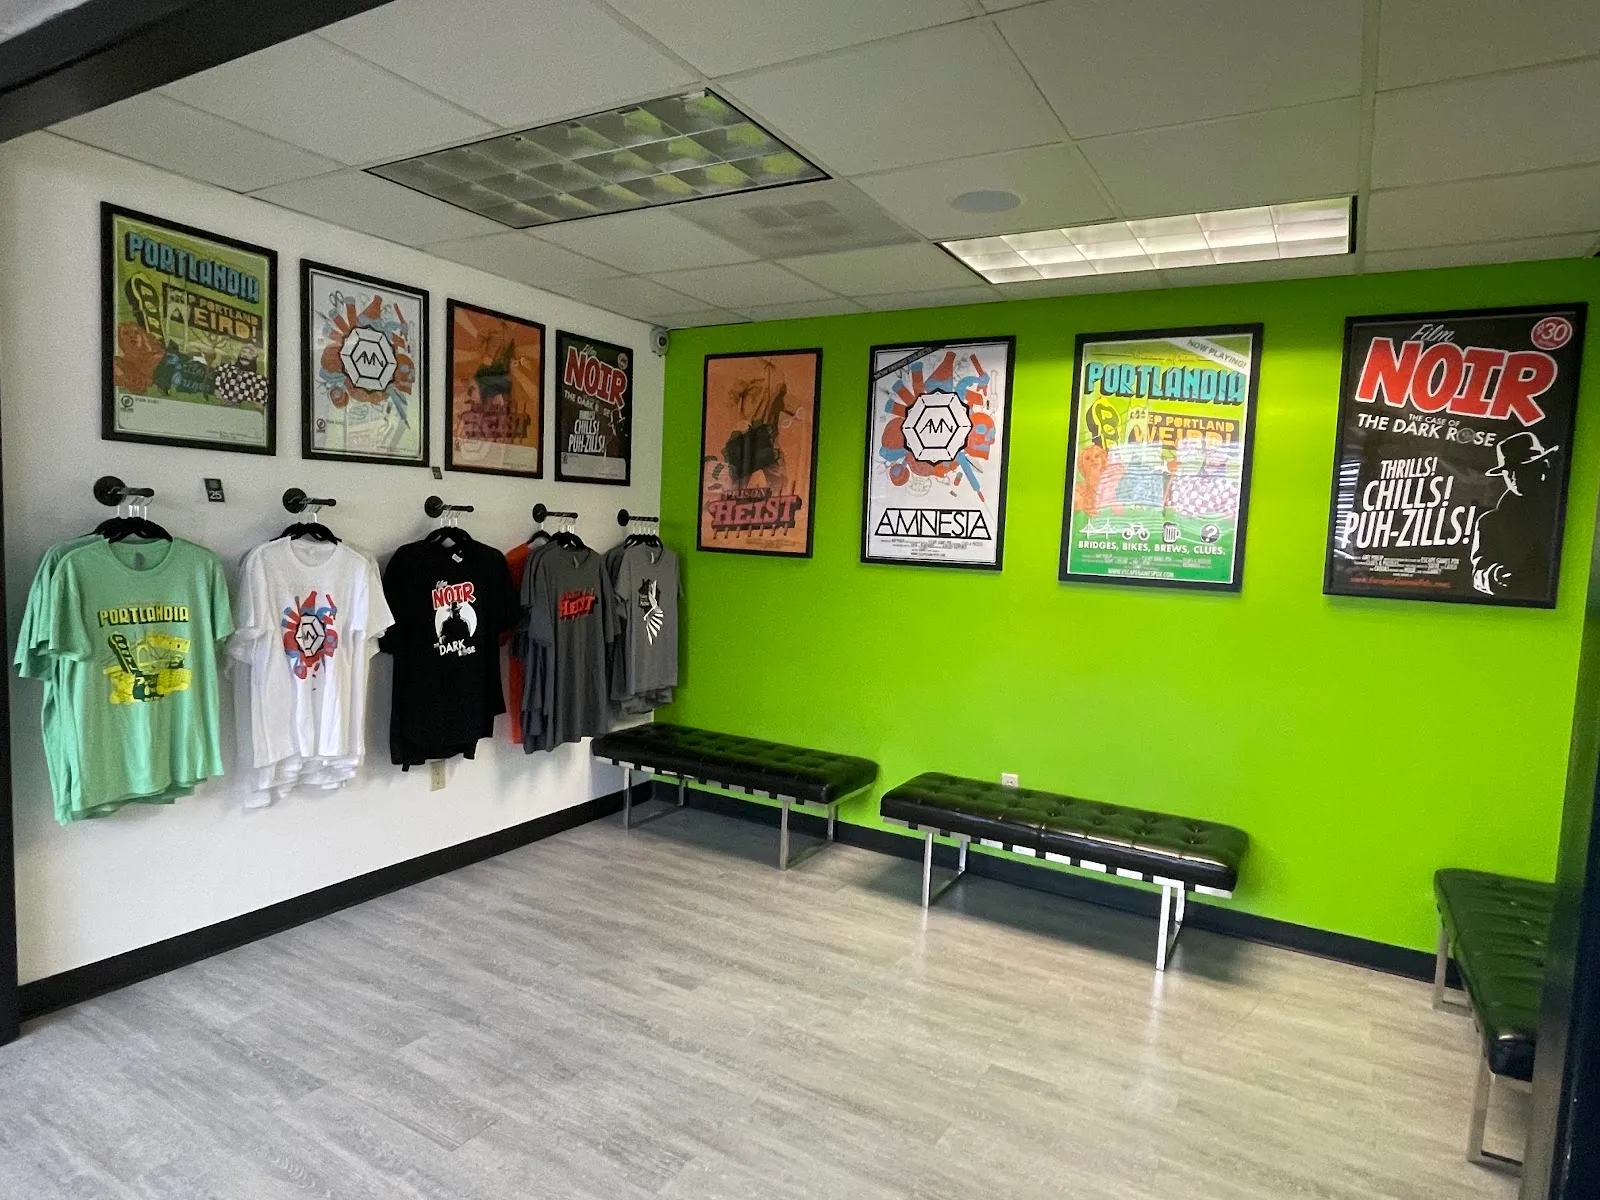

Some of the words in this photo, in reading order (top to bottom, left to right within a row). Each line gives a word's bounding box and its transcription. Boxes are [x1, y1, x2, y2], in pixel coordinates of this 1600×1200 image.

[126, 232, 260, 303] PORTLANDIA
[1410, 323, 1455, 342] Film
[1187, 339, 1208, 352] NOW
[1208, 347, 1247, 369] PLAYING!
[564, 345, 628, 409] NOIR
[1085, 361, 1246, 405] PORTLANDIA
[1355, 336, 1558, 427] NOIR
[564, 390, 576, 402] THE
[1165, 416, 1235, 432] PORTLAND
[1358, 413, 1389, 430] THE
[1392, 418, 1443, 439] DARK
[1408, 413, 1423, 421] THE
[1425, 416, 1447, 426] CASE
[1447, 419, 1460, 427] OF
[1380, 457, 1438, 480] THRILLS!
[1362, 475, 1454, 512] CHILLS!
[708, 495, 799, 527] HEIST
[875, 508, 991, 540] AMNESIA
[1341, 505, 1477, 549] PUH-ZILLS!
[1078, 540, 1119, 551] BRIDGES,
[1122, 542, 1151, 553] BIKES,
[1154, 544, 1190, 555] BREWS,
[1193, 545, 1226, 556] CLUES.
[432, 581, 476, 610] NOIR
[98, 606, 189, 628] PORTLANDIA
[439, 638, 466, 656] DARK
